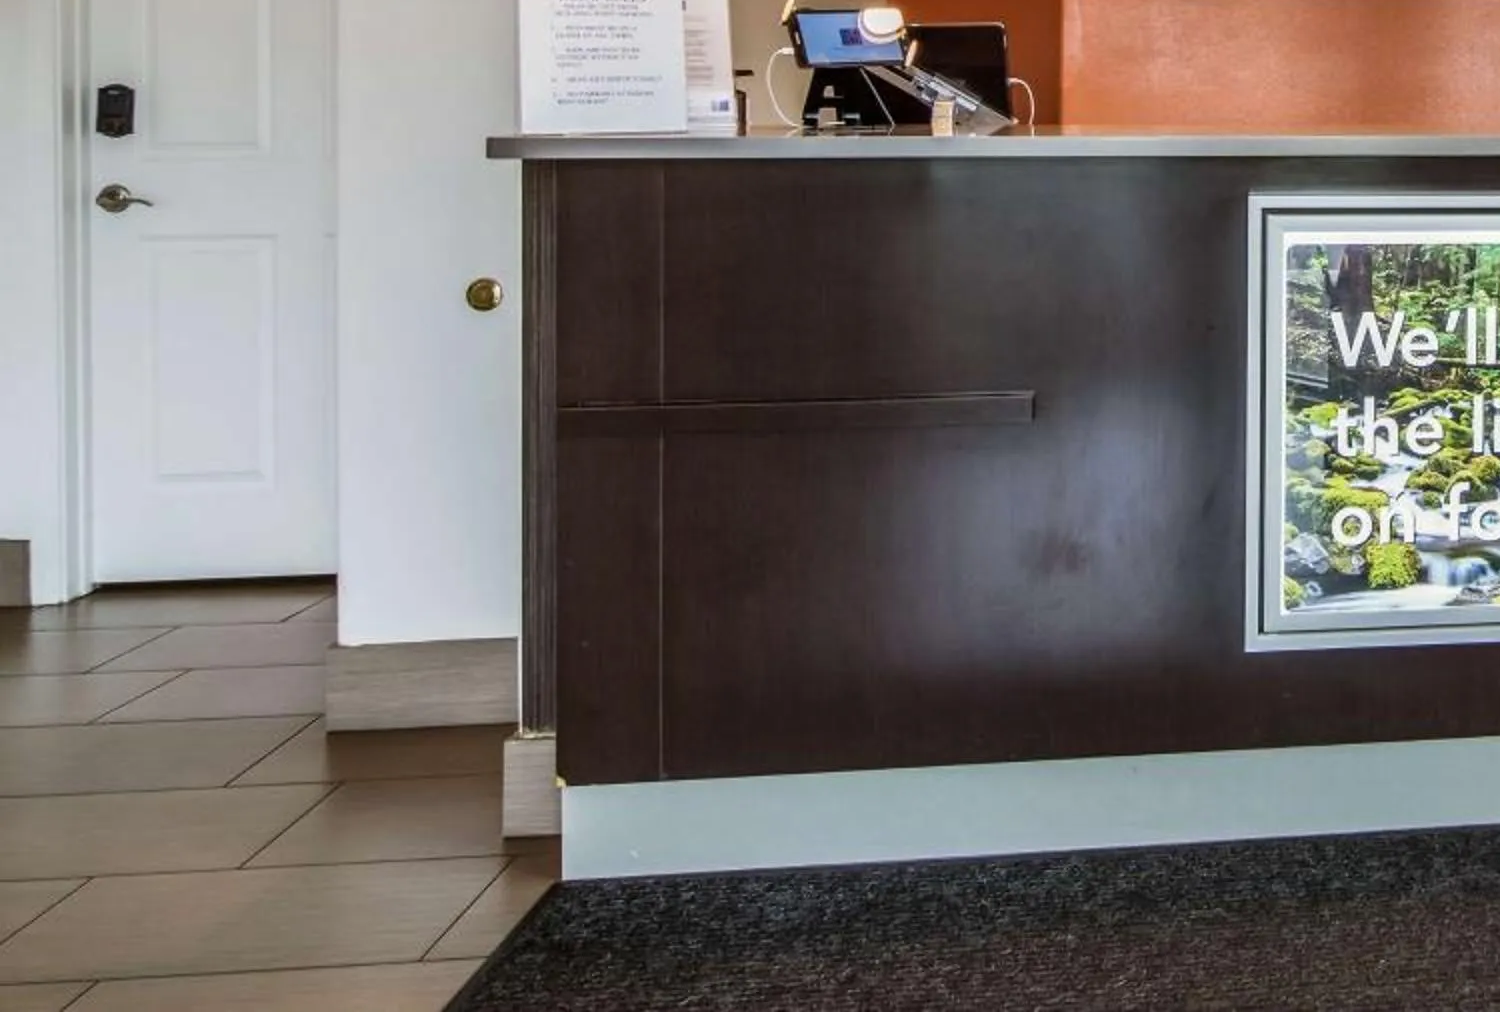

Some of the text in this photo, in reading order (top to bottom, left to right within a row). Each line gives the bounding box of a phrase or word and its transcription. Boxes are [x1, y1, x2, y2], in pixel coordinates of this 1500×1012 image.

[1330, 307, 1498, 368] We'll
[1332, 396, 1446, 458] the
[1330, 502, 1417, 548] on
